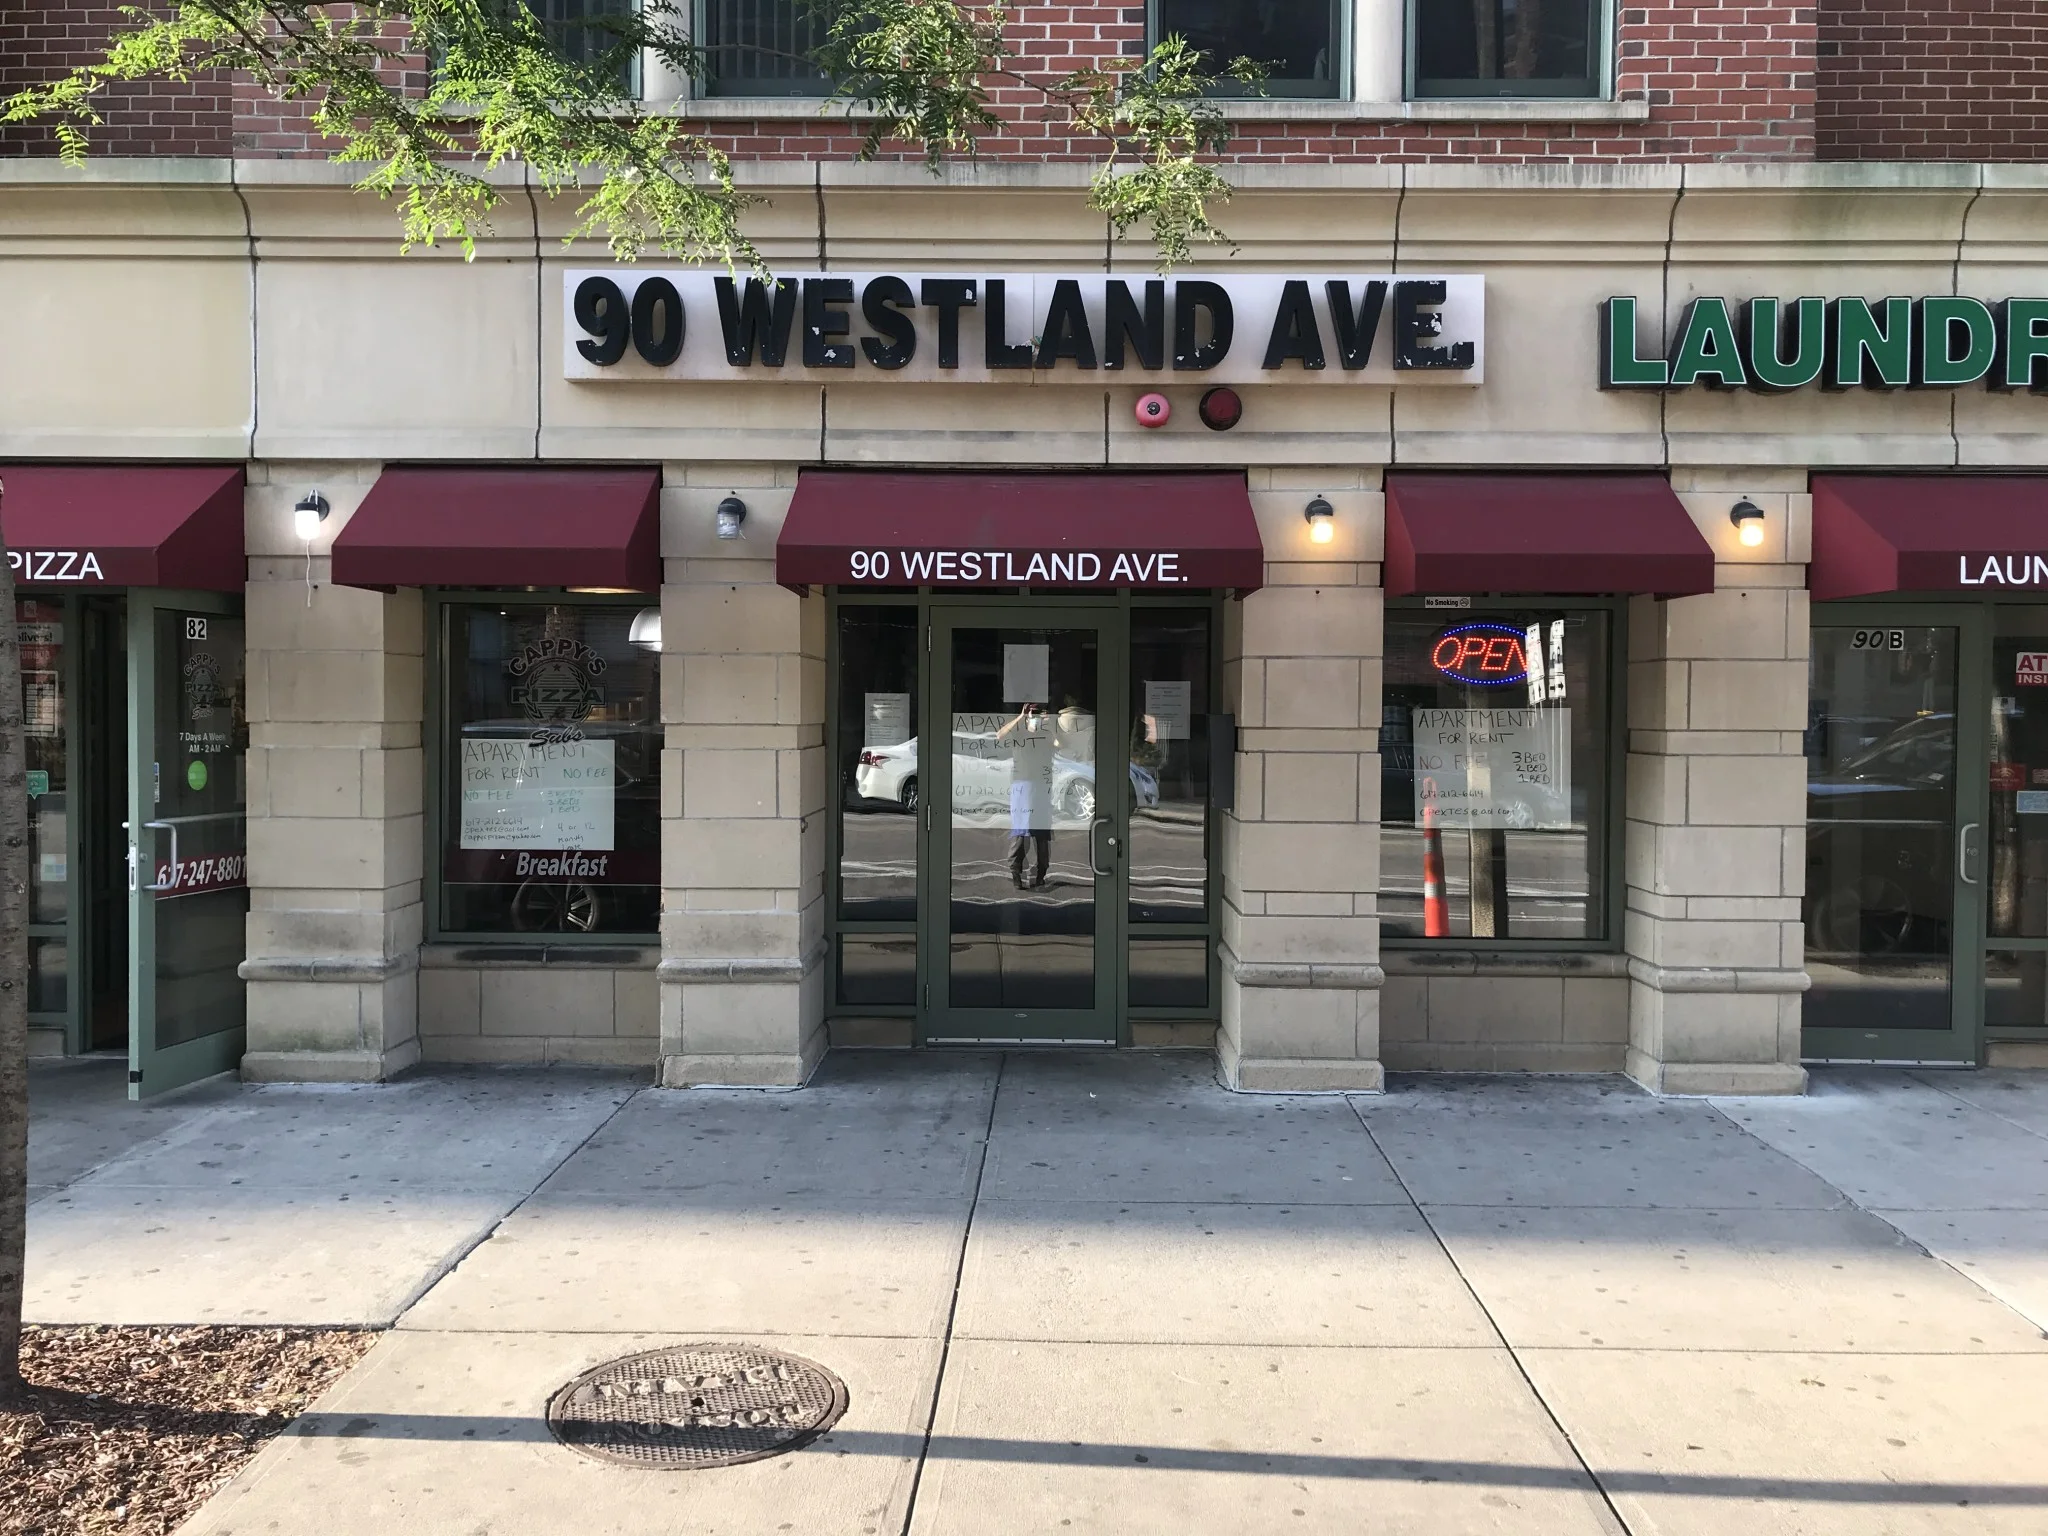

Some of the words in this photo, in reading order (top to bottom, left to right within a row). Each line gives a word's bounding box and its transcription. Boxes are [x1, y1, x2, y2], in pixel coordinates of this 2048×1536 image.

[573, 275, 686, 367] 90
[713, 275, 1234, 370] WESTLAND
[1261, 279, 1475, 370] AVE.
[850, 550, 889, 580] 90
[901, 551, 1100, 581] WESTLAND
[1110, 553, 1189, 582] AVE.
[1435, 599, 1459, 607] Smoking
[187, 619, 206, 639] 82
[1853, 630, 1884, 649] 90
[508, 638, 607, 676] CAPPY'S
[186, 683, 220, 692] PIZZA
[512, 688, 603, 702] PIZZA
[1418, 709, 1536, 729] APARTMENT
[179, 732, 184, 741] 7
[185, 732, 202, 743] Days
[202, 732, 208, 741] A
[528, 727, 585, 748] Subs
[960, 737, 985, 751] FOR
[993, 735, 1046, 750] RENT
[1438, 732, 1464, 745] FOR
[1469, 732, 1515, 745] RENT
[189, 744, 200, 753] AM
[463, 740, 592, 763] APARTMENT
[1418, 755, 1443, 770] NO
[465, 766, 494, 783] FOR
[501, 766, 544, 781] RENT
[563, 768, 582, 779] NO
[464, 789, 479, 801] NO
[157, 855, 246, 889] 67-247-8801
[515, 852, 608, 877] Breakfast
[599, 1364, 790, 1398] DRAIN
